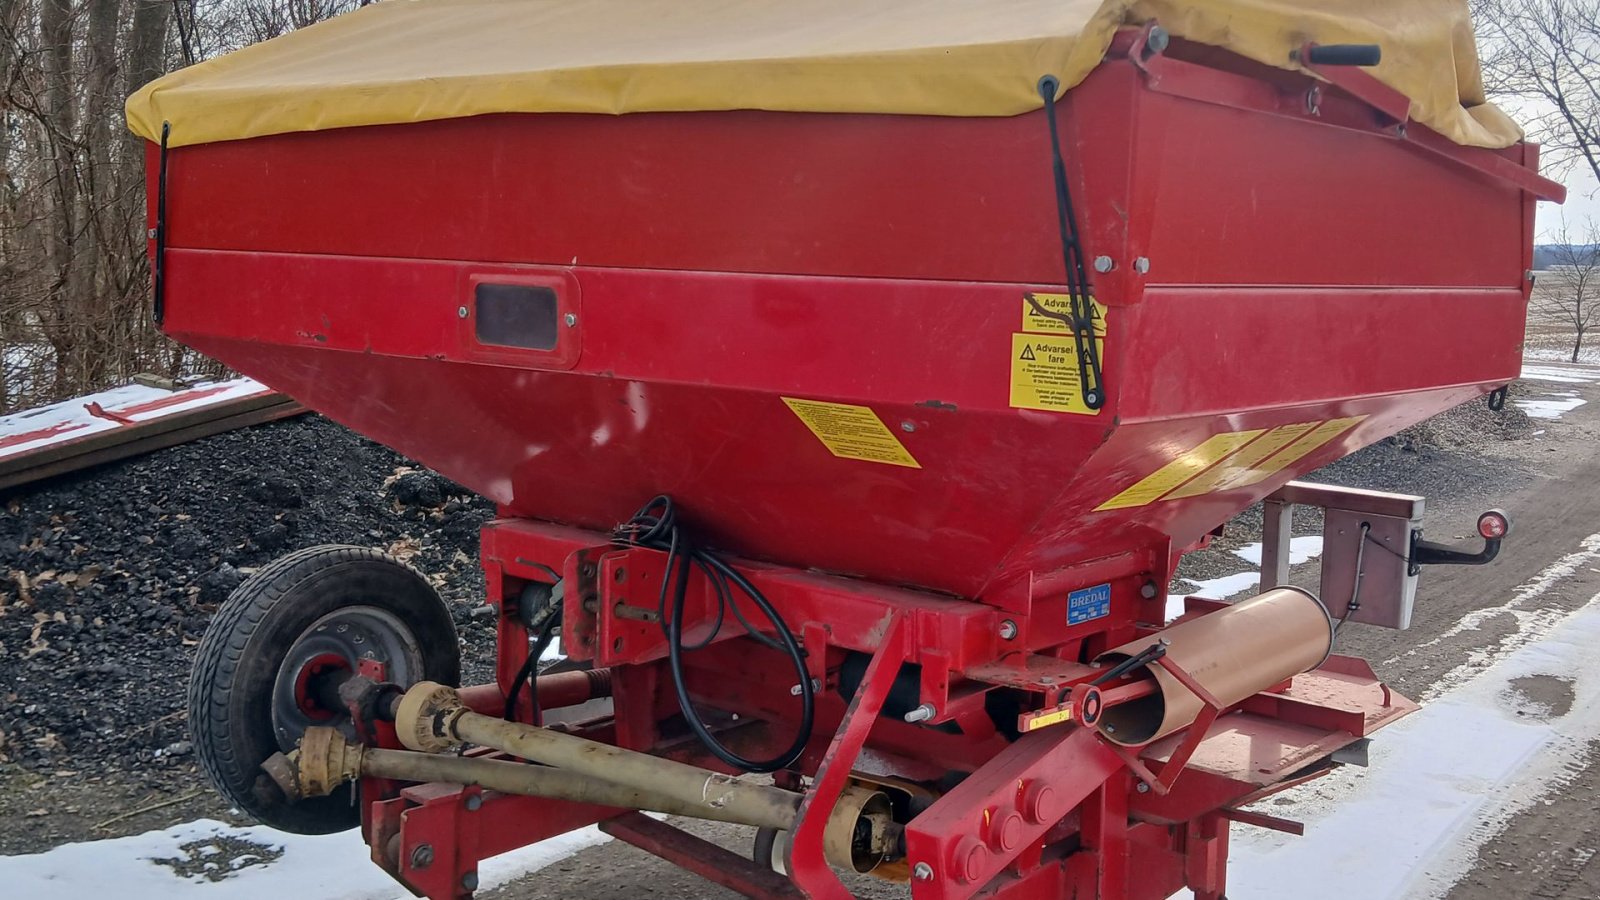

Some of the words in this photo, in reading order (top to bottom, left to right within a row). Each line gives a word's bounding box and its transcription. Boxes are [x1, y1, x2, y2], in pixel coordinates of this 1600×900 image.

[1035, 343, 1073, 354] Advarsel
[1048, 354, 1065, 364] fare
[1071, 591, 1108, 608] BREDAL
